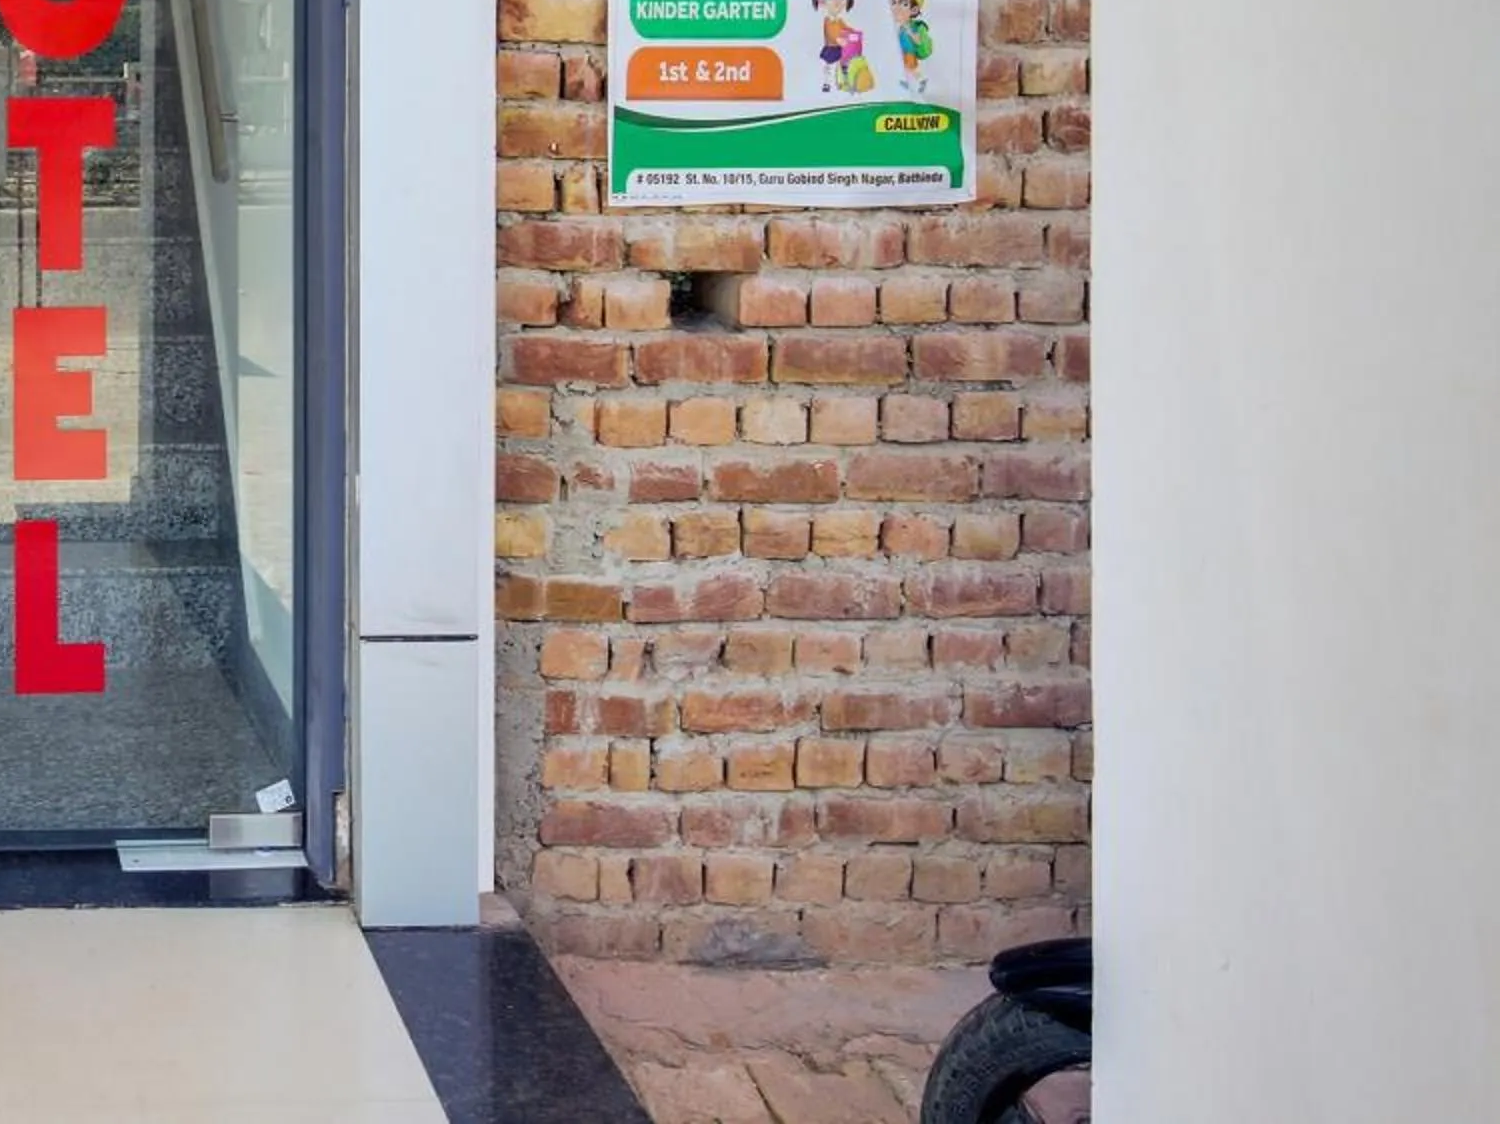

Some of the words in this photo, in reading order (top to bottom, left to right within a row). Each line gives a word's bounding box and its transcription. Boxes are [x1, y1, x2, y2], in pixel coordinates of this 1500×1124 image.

[636, 1, 699, 20] KINDER
[703, 1, 777, 20] GARTEN
[659, 61, 688, 82] 1st
[695, 60, 710, 82] &
[714, 60, 751, 82] 2nd
[759, 173, 785, 185] Guru
[827, 172, 859, 187] Singh
